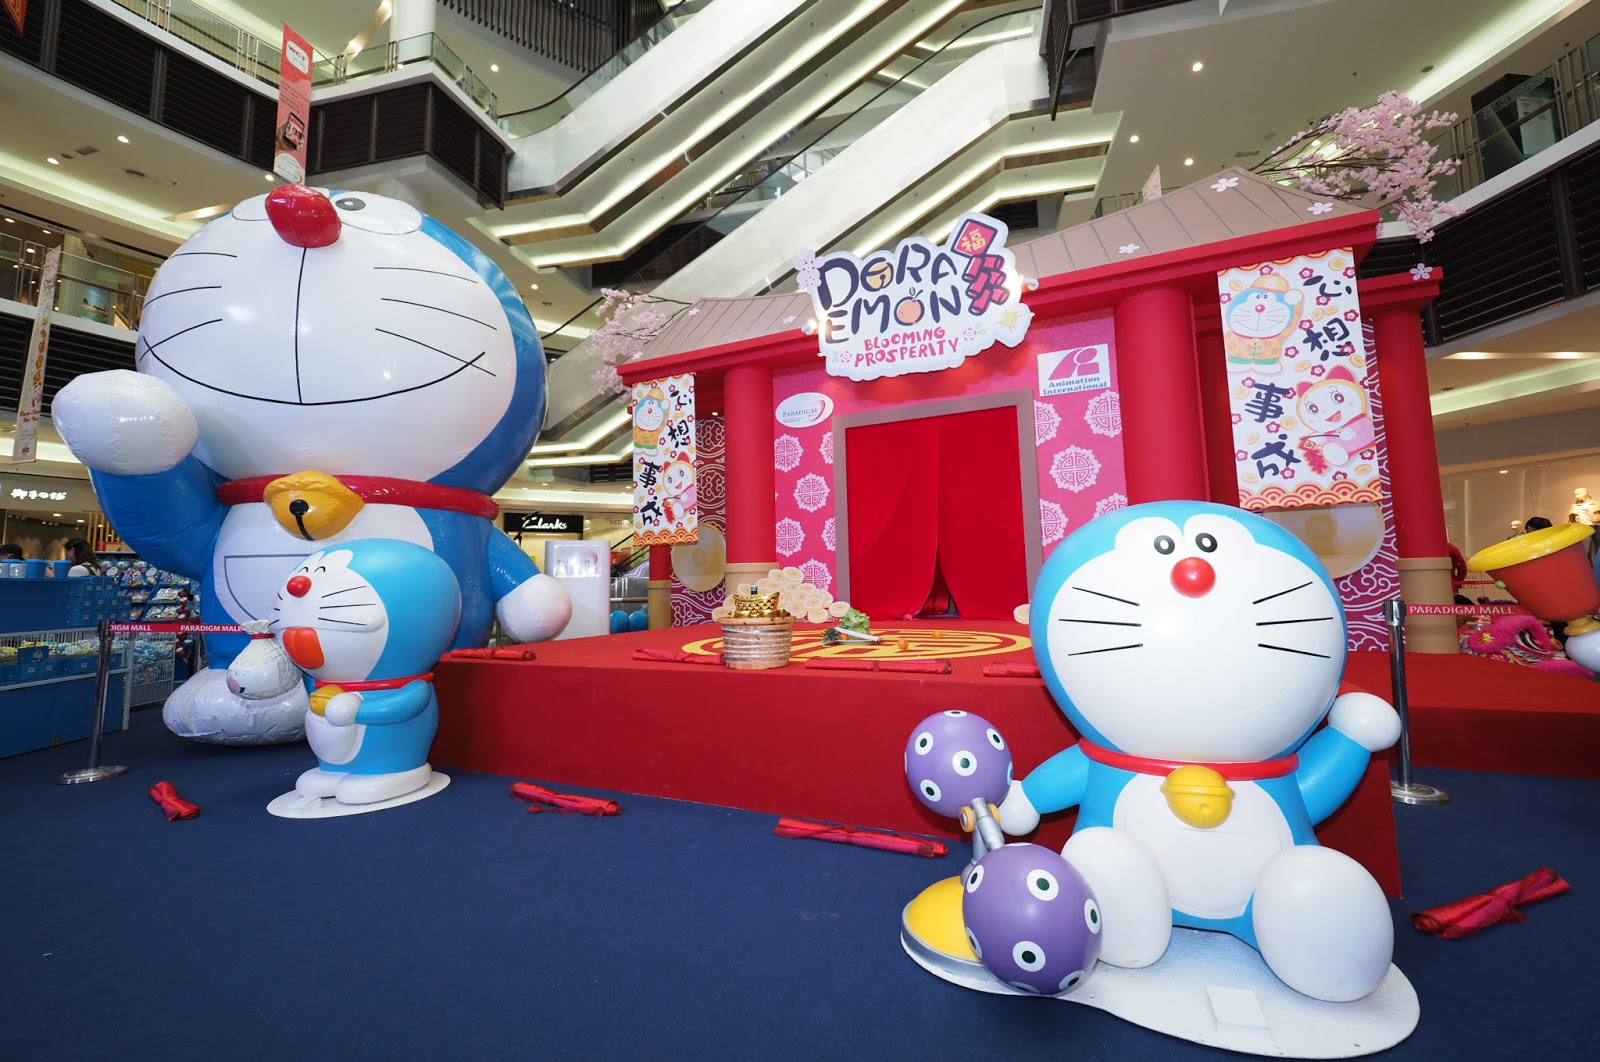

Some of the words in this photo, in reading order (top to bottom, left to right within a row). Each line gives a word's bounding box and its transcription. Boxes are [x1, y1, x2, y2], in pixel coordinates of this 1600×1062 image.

[961, 228, 987, 253] 福
[816, 243, 958, 310] DORA
[864, 326, 946, 350] BLOOMING
[854, 337, 959, 368] PROSPERITY
[1043, 381, 1107, 396] International
[1048, 376, 1100, 388] Animation
[782, 408, 818, 418] PARADIGM
[522, 516, 568, 530] Clarks
[1409, 605, 1476, 615] PARADIGM
[1479, 605, 1515, 615] MALL
[180, 624, 220, 632] PARADIGM
